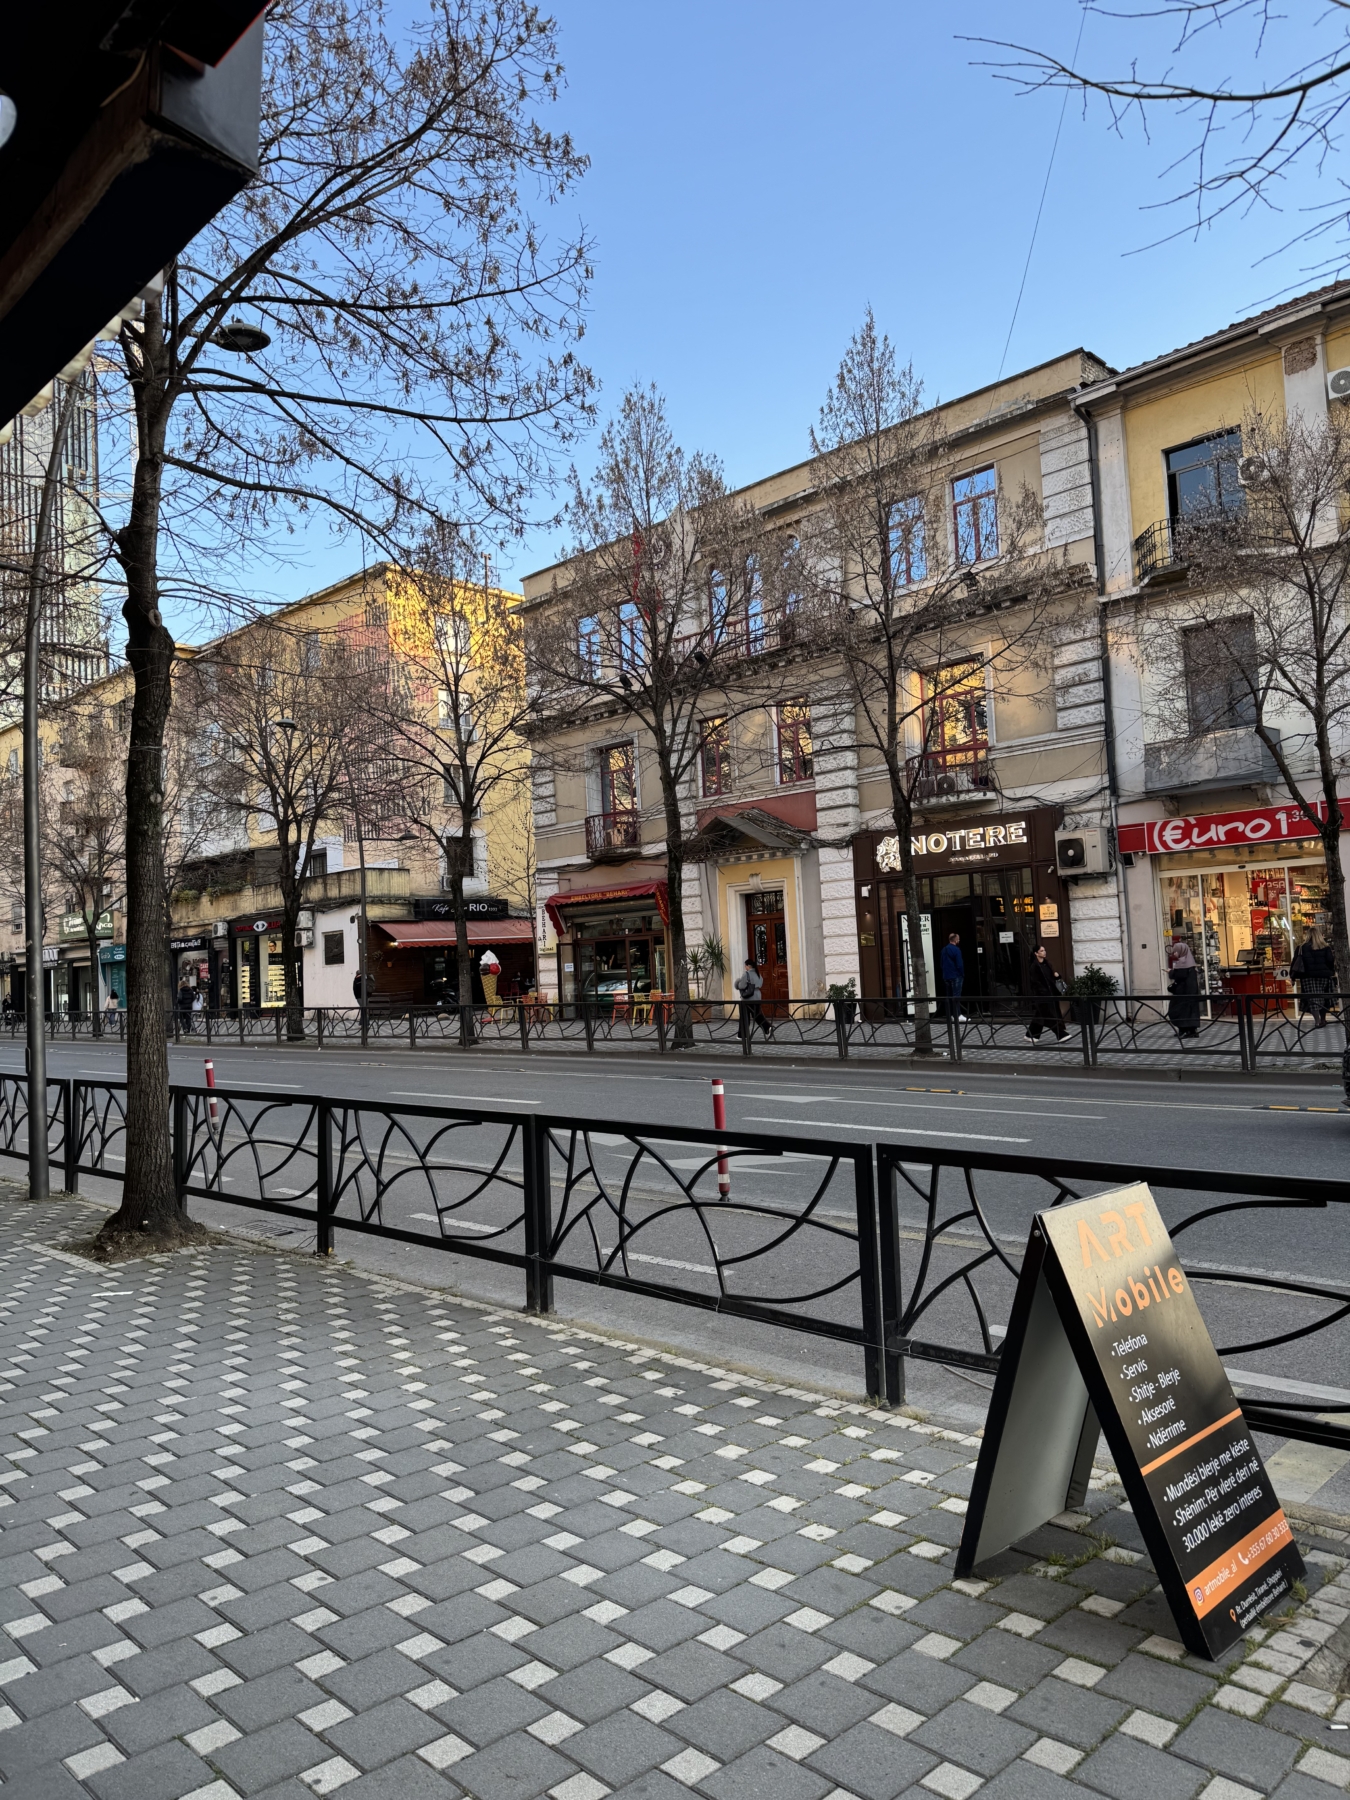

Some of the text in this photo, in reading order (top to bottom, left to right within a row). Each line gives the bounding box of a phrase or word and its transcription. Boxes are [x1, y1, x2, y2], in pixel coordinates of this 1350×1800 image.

[911, 821, 1027, 856] NOTERE
[469, 903, 487, 912] RIO
[1077, 1201, 1153, 1269] ART
[1086, 1265, 1184, 1329] Mobile
[1112, 1334, 1148, 1357] Telefona
[1123, 1358, 1148, 1380] Servis
[1131, 1381, 1156, 1403] Shitje
[1157, 1368, 1181, 1388] Blerje
[1141, 1395, 1176, 1426] Aksesorë
[1149, 1419, 1187, 1449] Ndërrime
[1166, 1439, 1250, 1502] Mundësi blerje me këste
[1175, 1456, 1260, 1526] Shënim: Për vlerë deri në
[1182, 1486, 1263, 1553] 30.000 lekë zero interes
[1203, 1559, 1238, 1596] artmobile_al
[1259, 1537, 1267, 1551] 67
